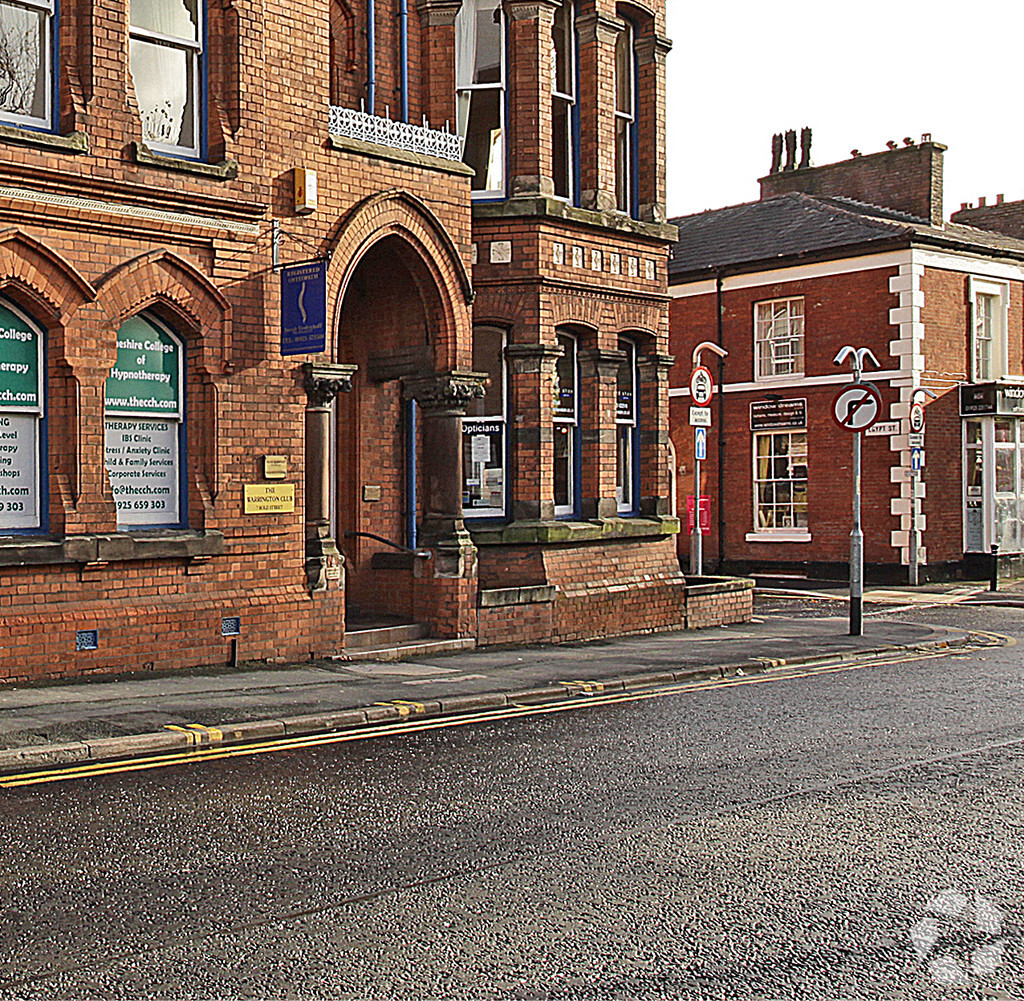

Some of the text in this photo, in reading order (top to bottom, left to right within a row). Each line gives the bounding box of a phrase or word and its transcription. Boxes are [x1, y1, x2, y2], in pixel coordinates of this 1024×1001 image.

[287, 266, 320, 277] REGISTERED
[116, 338, 174, 353] eshire College
[136, 354, 146, 365] of
[111, 367, 171, 383] Hypnotherapy
[104, 396, 177, 408] www.thecch.com
[105, 421, 168, 431] THERAPY SERVICES
[462, 424, 499, 434] Opticians
[122, 434, 151, 443] IBS Clinic
[106, 446, 120, 454] tress
[126, 446, 151, 455] Anxiety
[152, 446, 170, 454] Clinic
[118, 458, 124, 466] &
[125, 458, 148, 467] Family
[149, 458, 174, 466] Services
[108, 469, 166, 478] Corporate Services
[112, 485, 170, 496] fo@thecch.com
[7, 502, 24, 511] 303
[115, 500, 166, 510] 925 659 303
